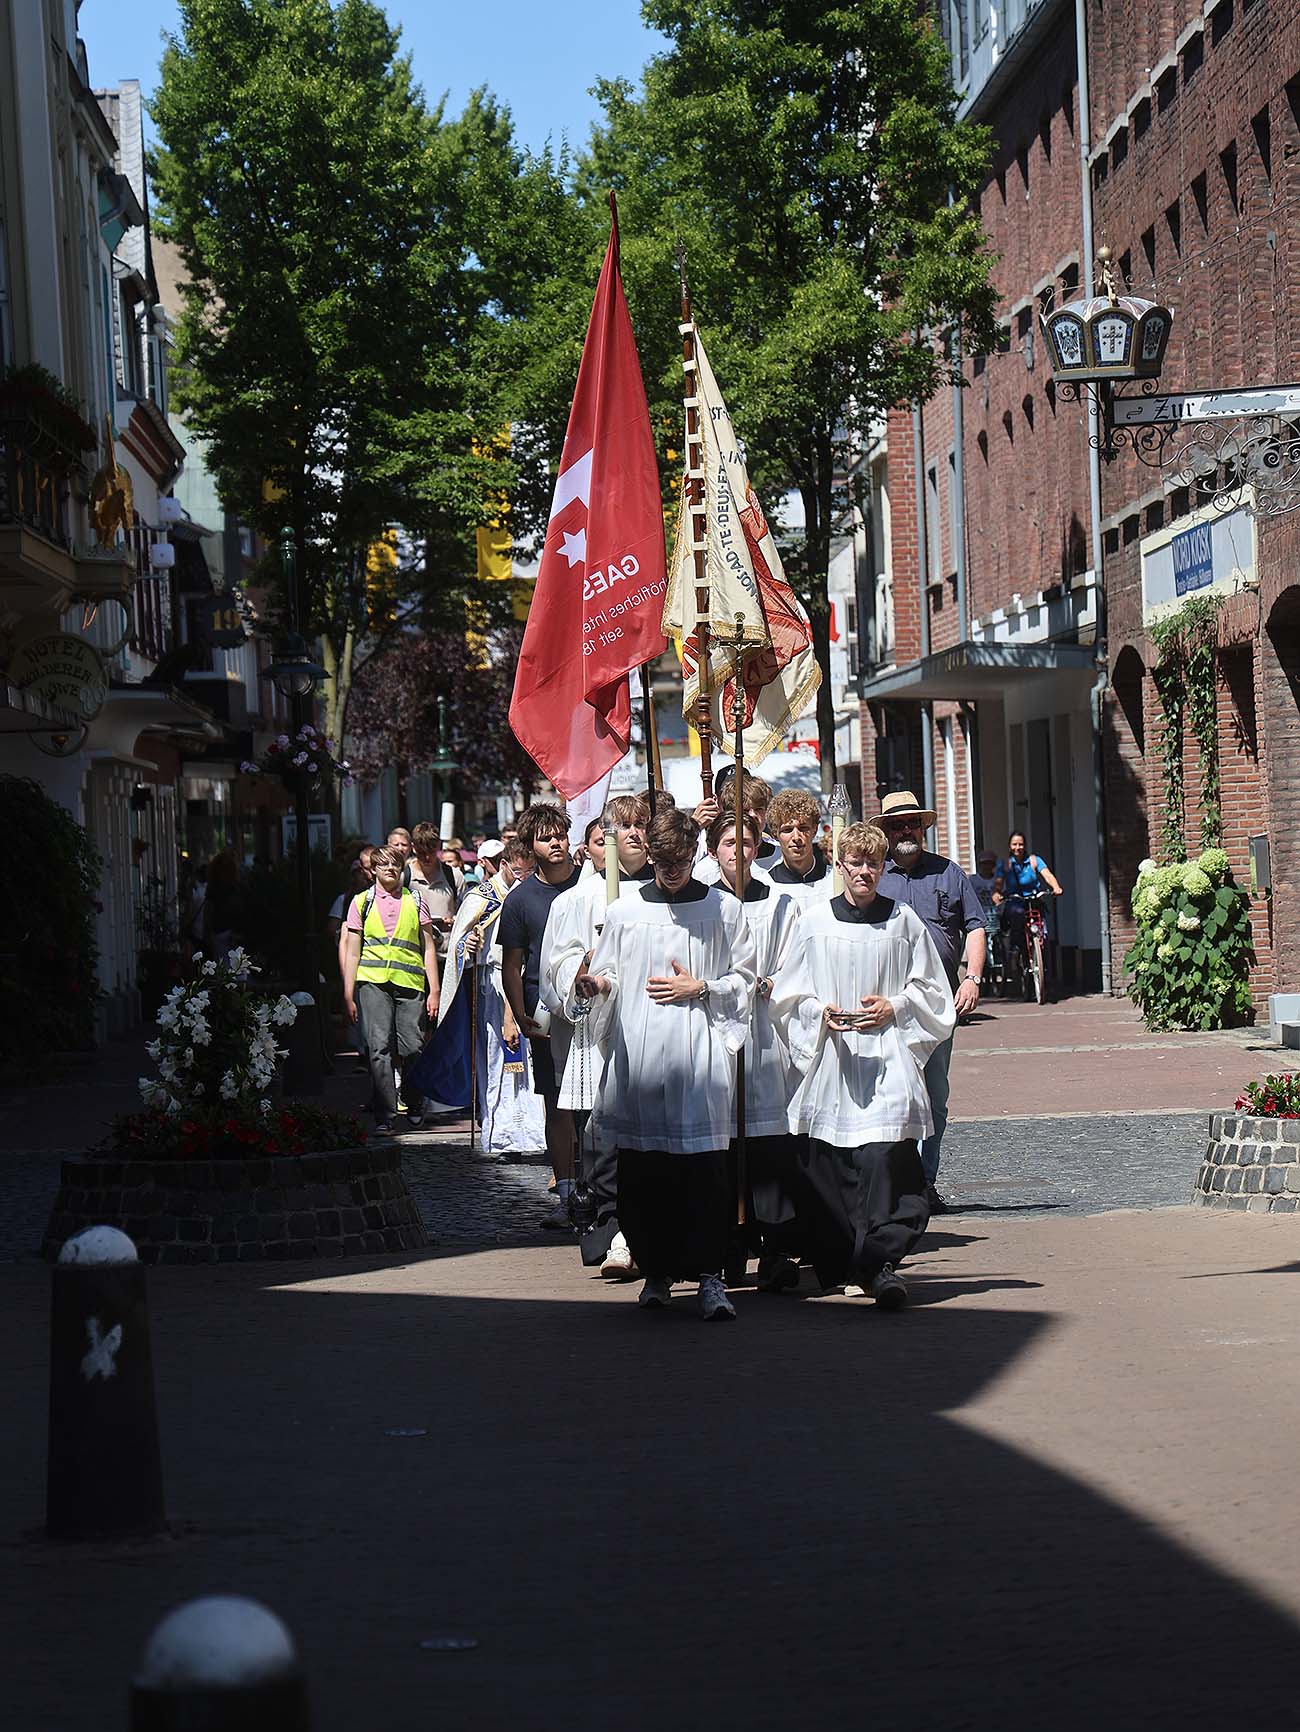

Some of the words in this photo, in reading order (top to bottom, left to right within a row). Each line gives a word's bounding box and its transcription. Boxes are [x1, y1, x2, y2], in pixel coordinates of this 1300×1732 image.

[1153, 398, 1195, 420] Zur
[1190, 524, 1212, 566] KIOSK
[22, 638, 85, 664] HOTEL
